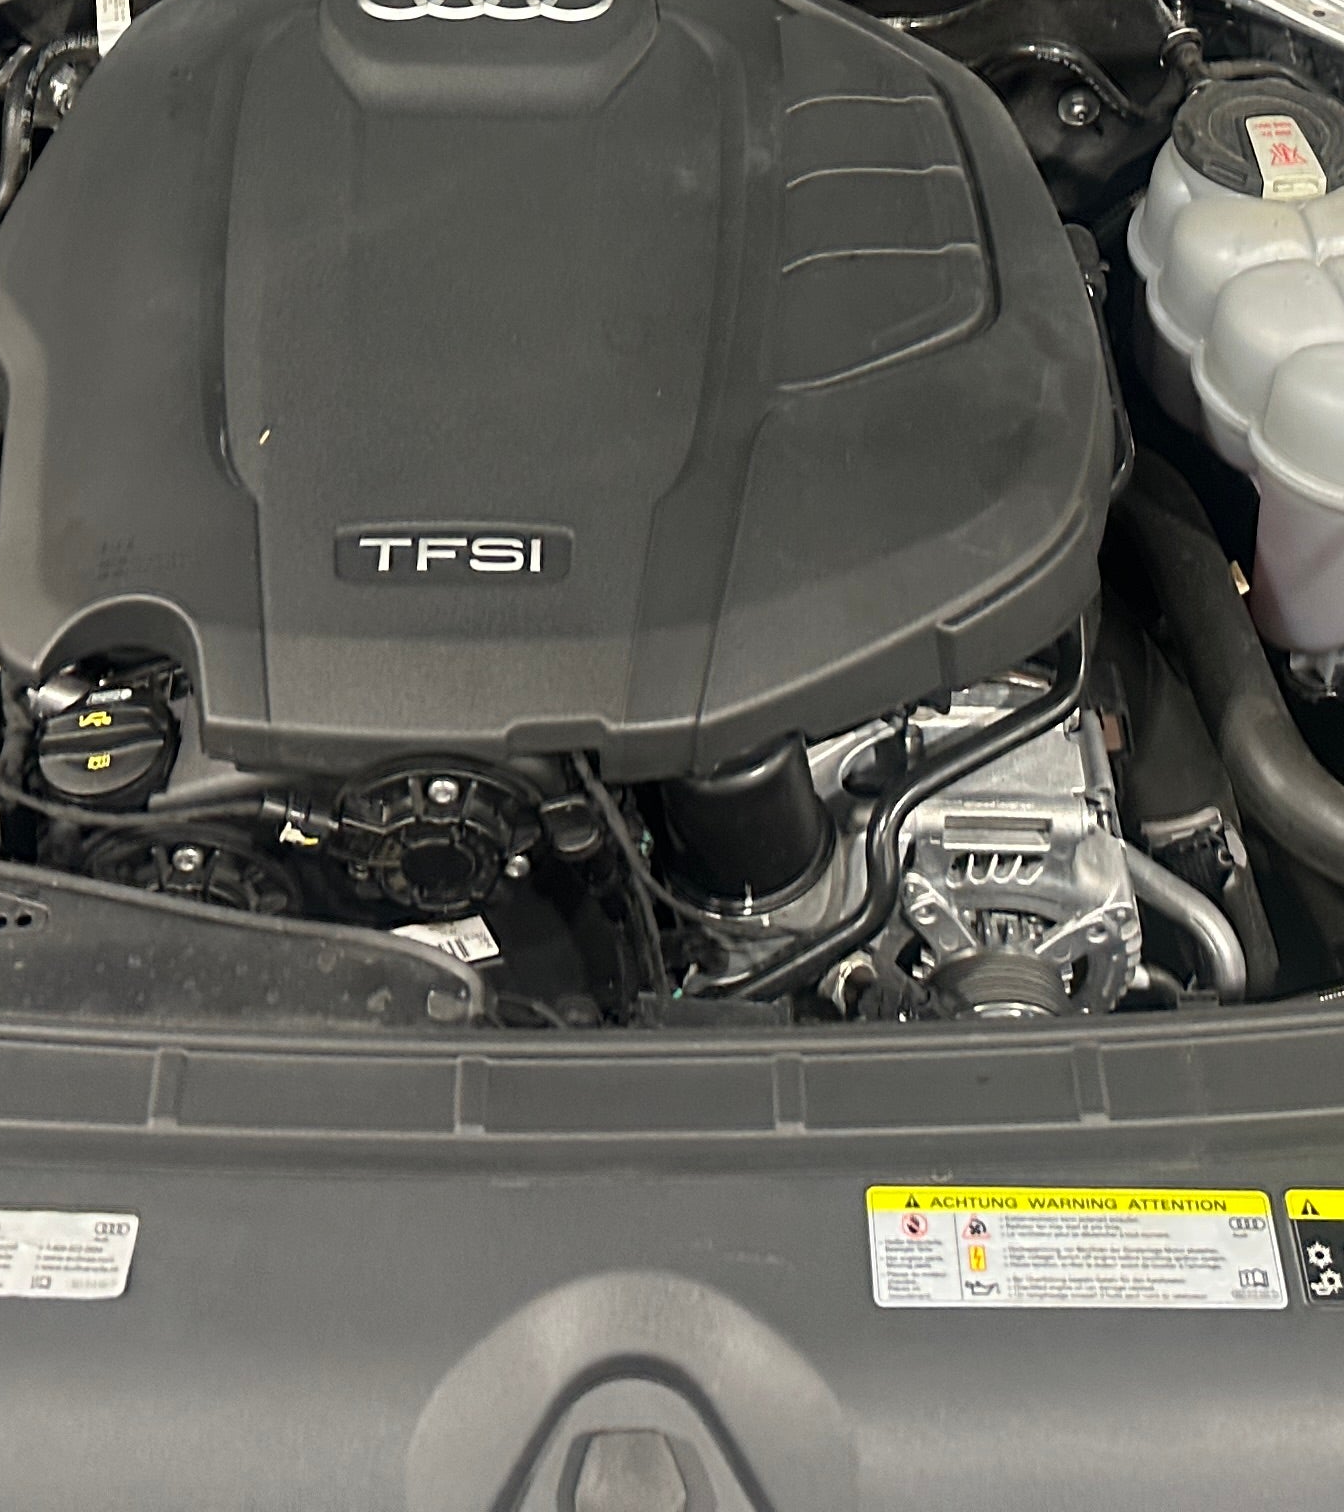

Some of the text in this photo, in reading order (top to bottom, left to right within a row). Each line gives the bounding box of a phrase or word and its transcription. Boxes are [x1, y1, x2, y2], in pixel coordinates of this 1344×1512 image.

[359, 538, 541, 572] TFSI
[930, 1196, 1227, 1212] ACHTUNG WARNING ATTENTION
